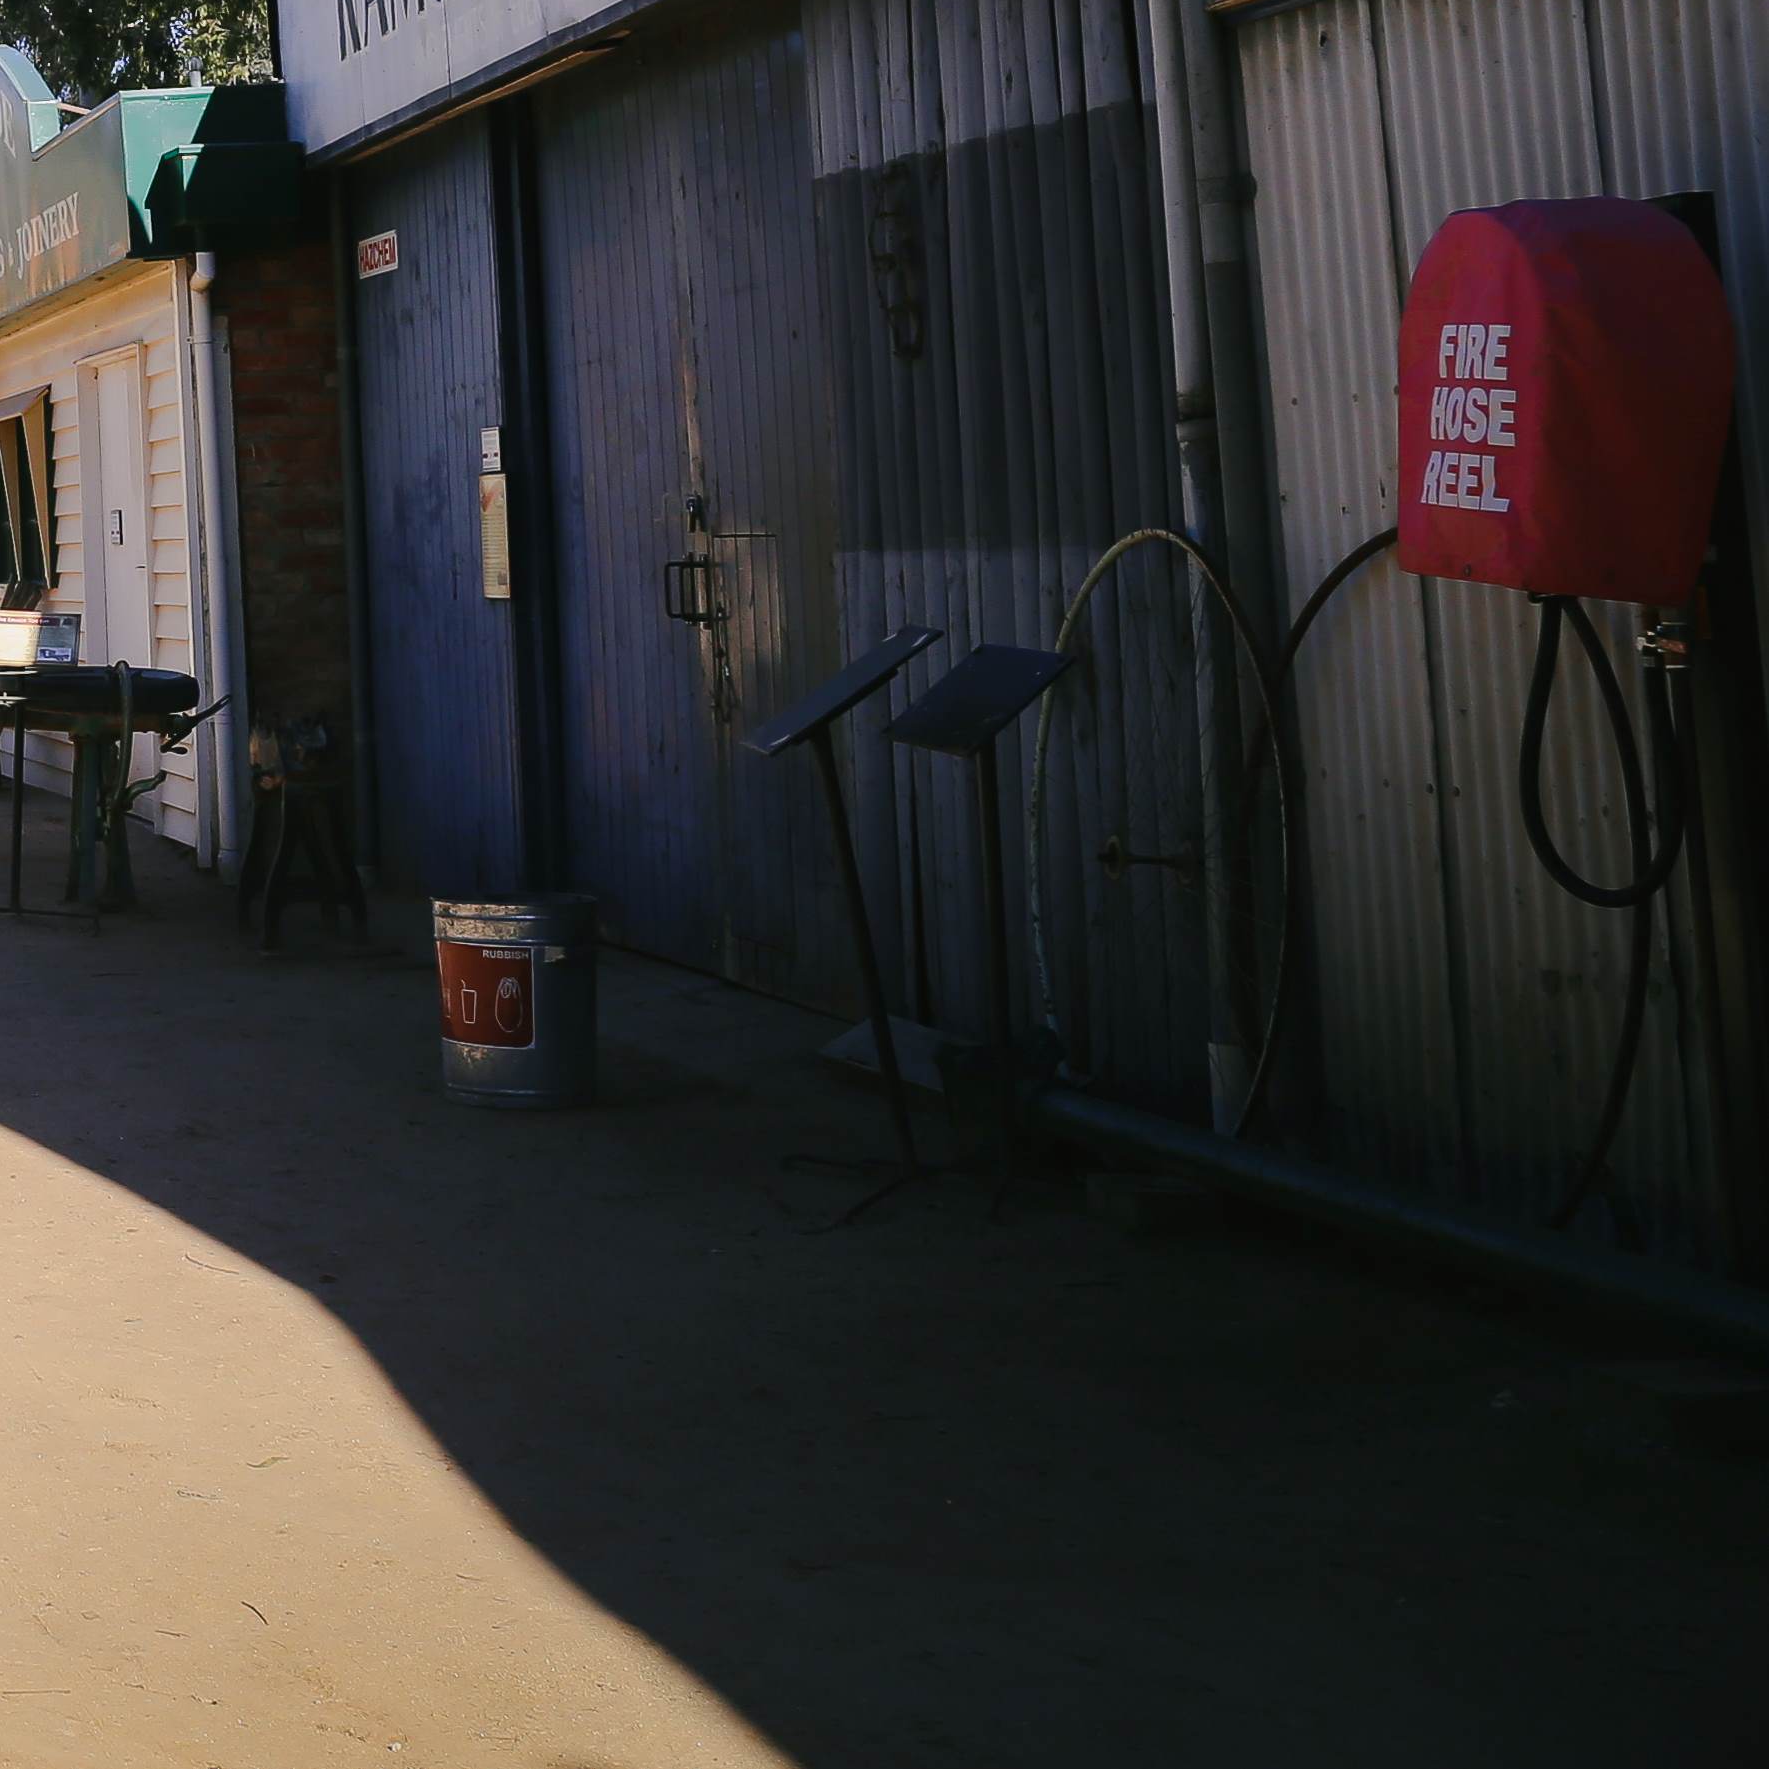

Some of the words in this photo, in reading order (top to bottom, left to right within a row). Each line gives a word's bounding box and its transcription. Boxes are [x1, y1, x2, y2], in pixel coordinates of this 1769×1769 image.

[15, 191, 80, 281] JOINERY
[359, 235, 397, 273] HAZCHEM
[1438, 324, 1512, 381] FIRE
[1430, 387, 1517, 447] HOSE
[1420, 450, 1511, 513] REEL
[482, 949, 529, 960] RUBBISH
